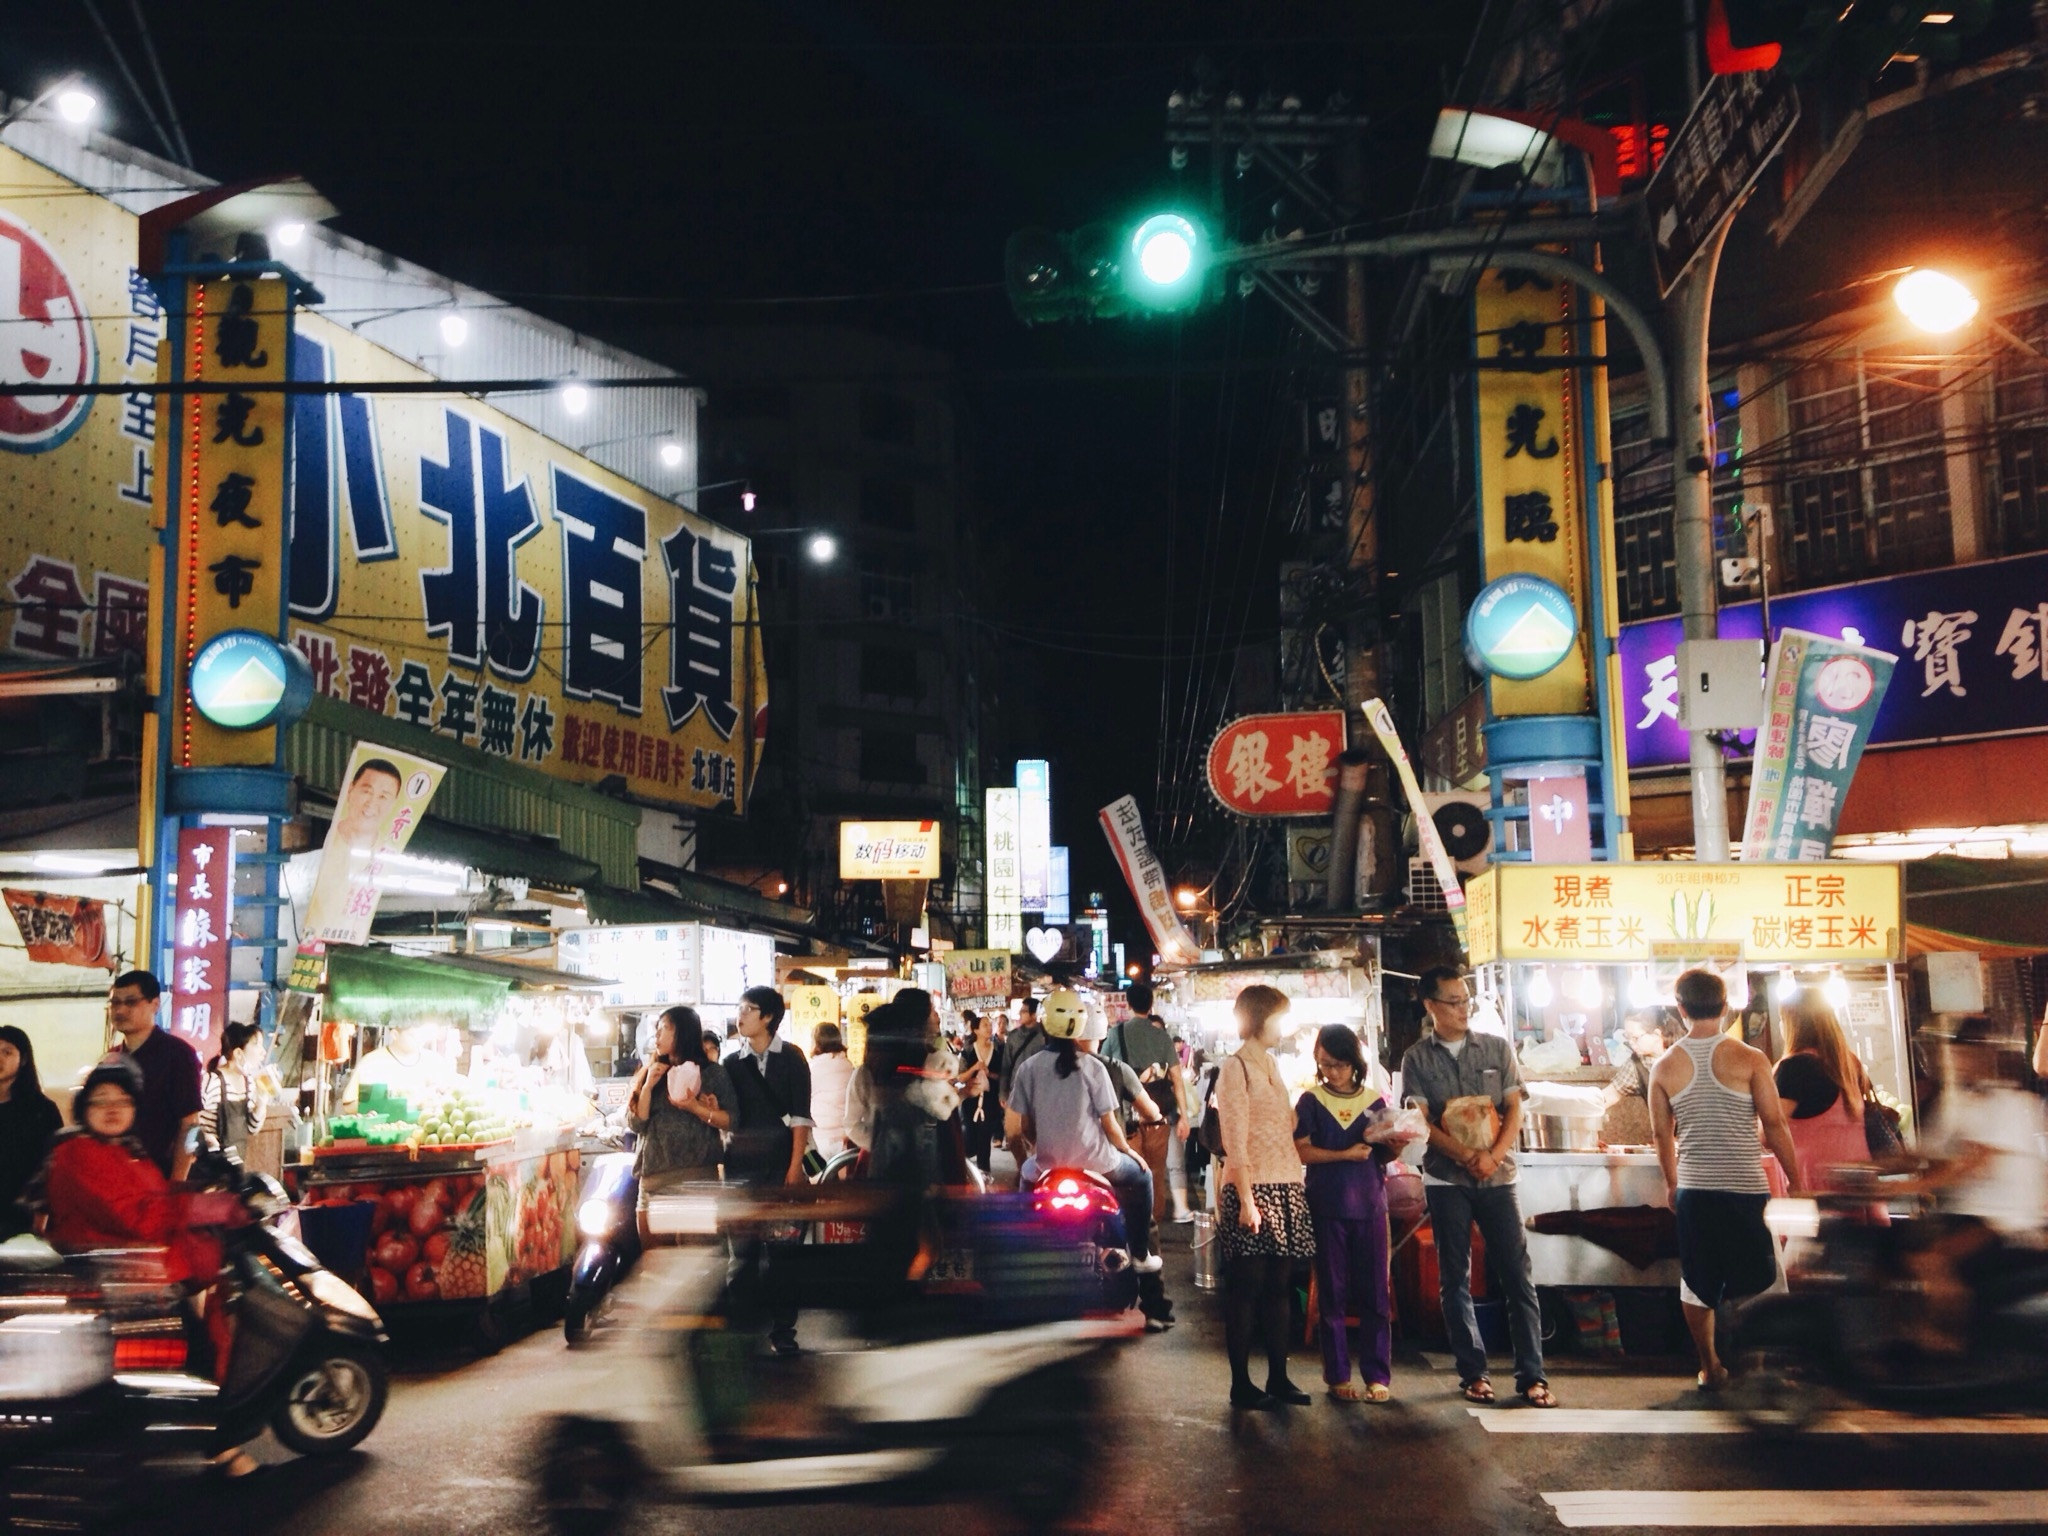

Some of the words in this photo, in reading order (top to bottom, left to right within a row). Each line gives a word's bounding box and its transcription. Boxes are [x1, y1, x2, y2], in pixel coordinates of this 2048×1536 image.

[394, 659, 556, 763] 全年無休
[561, 713, 685, 787] 歡迎使用信用卡
[692, 747, 735, 799] 北埔店
[1223, 729, 1335, 805] 銀樓
[855, 838, 927, 865] 数码移动
[1553, 874, 1614, 909] 現煮
[1784, 874, 1845, 908] 正宗
[183, 843, 219, 1041] 市長蘇家明
[1522, 915, 1645, 950] 水煮玉米
[1752, 915, 1878, 951] 碳烤玉米
